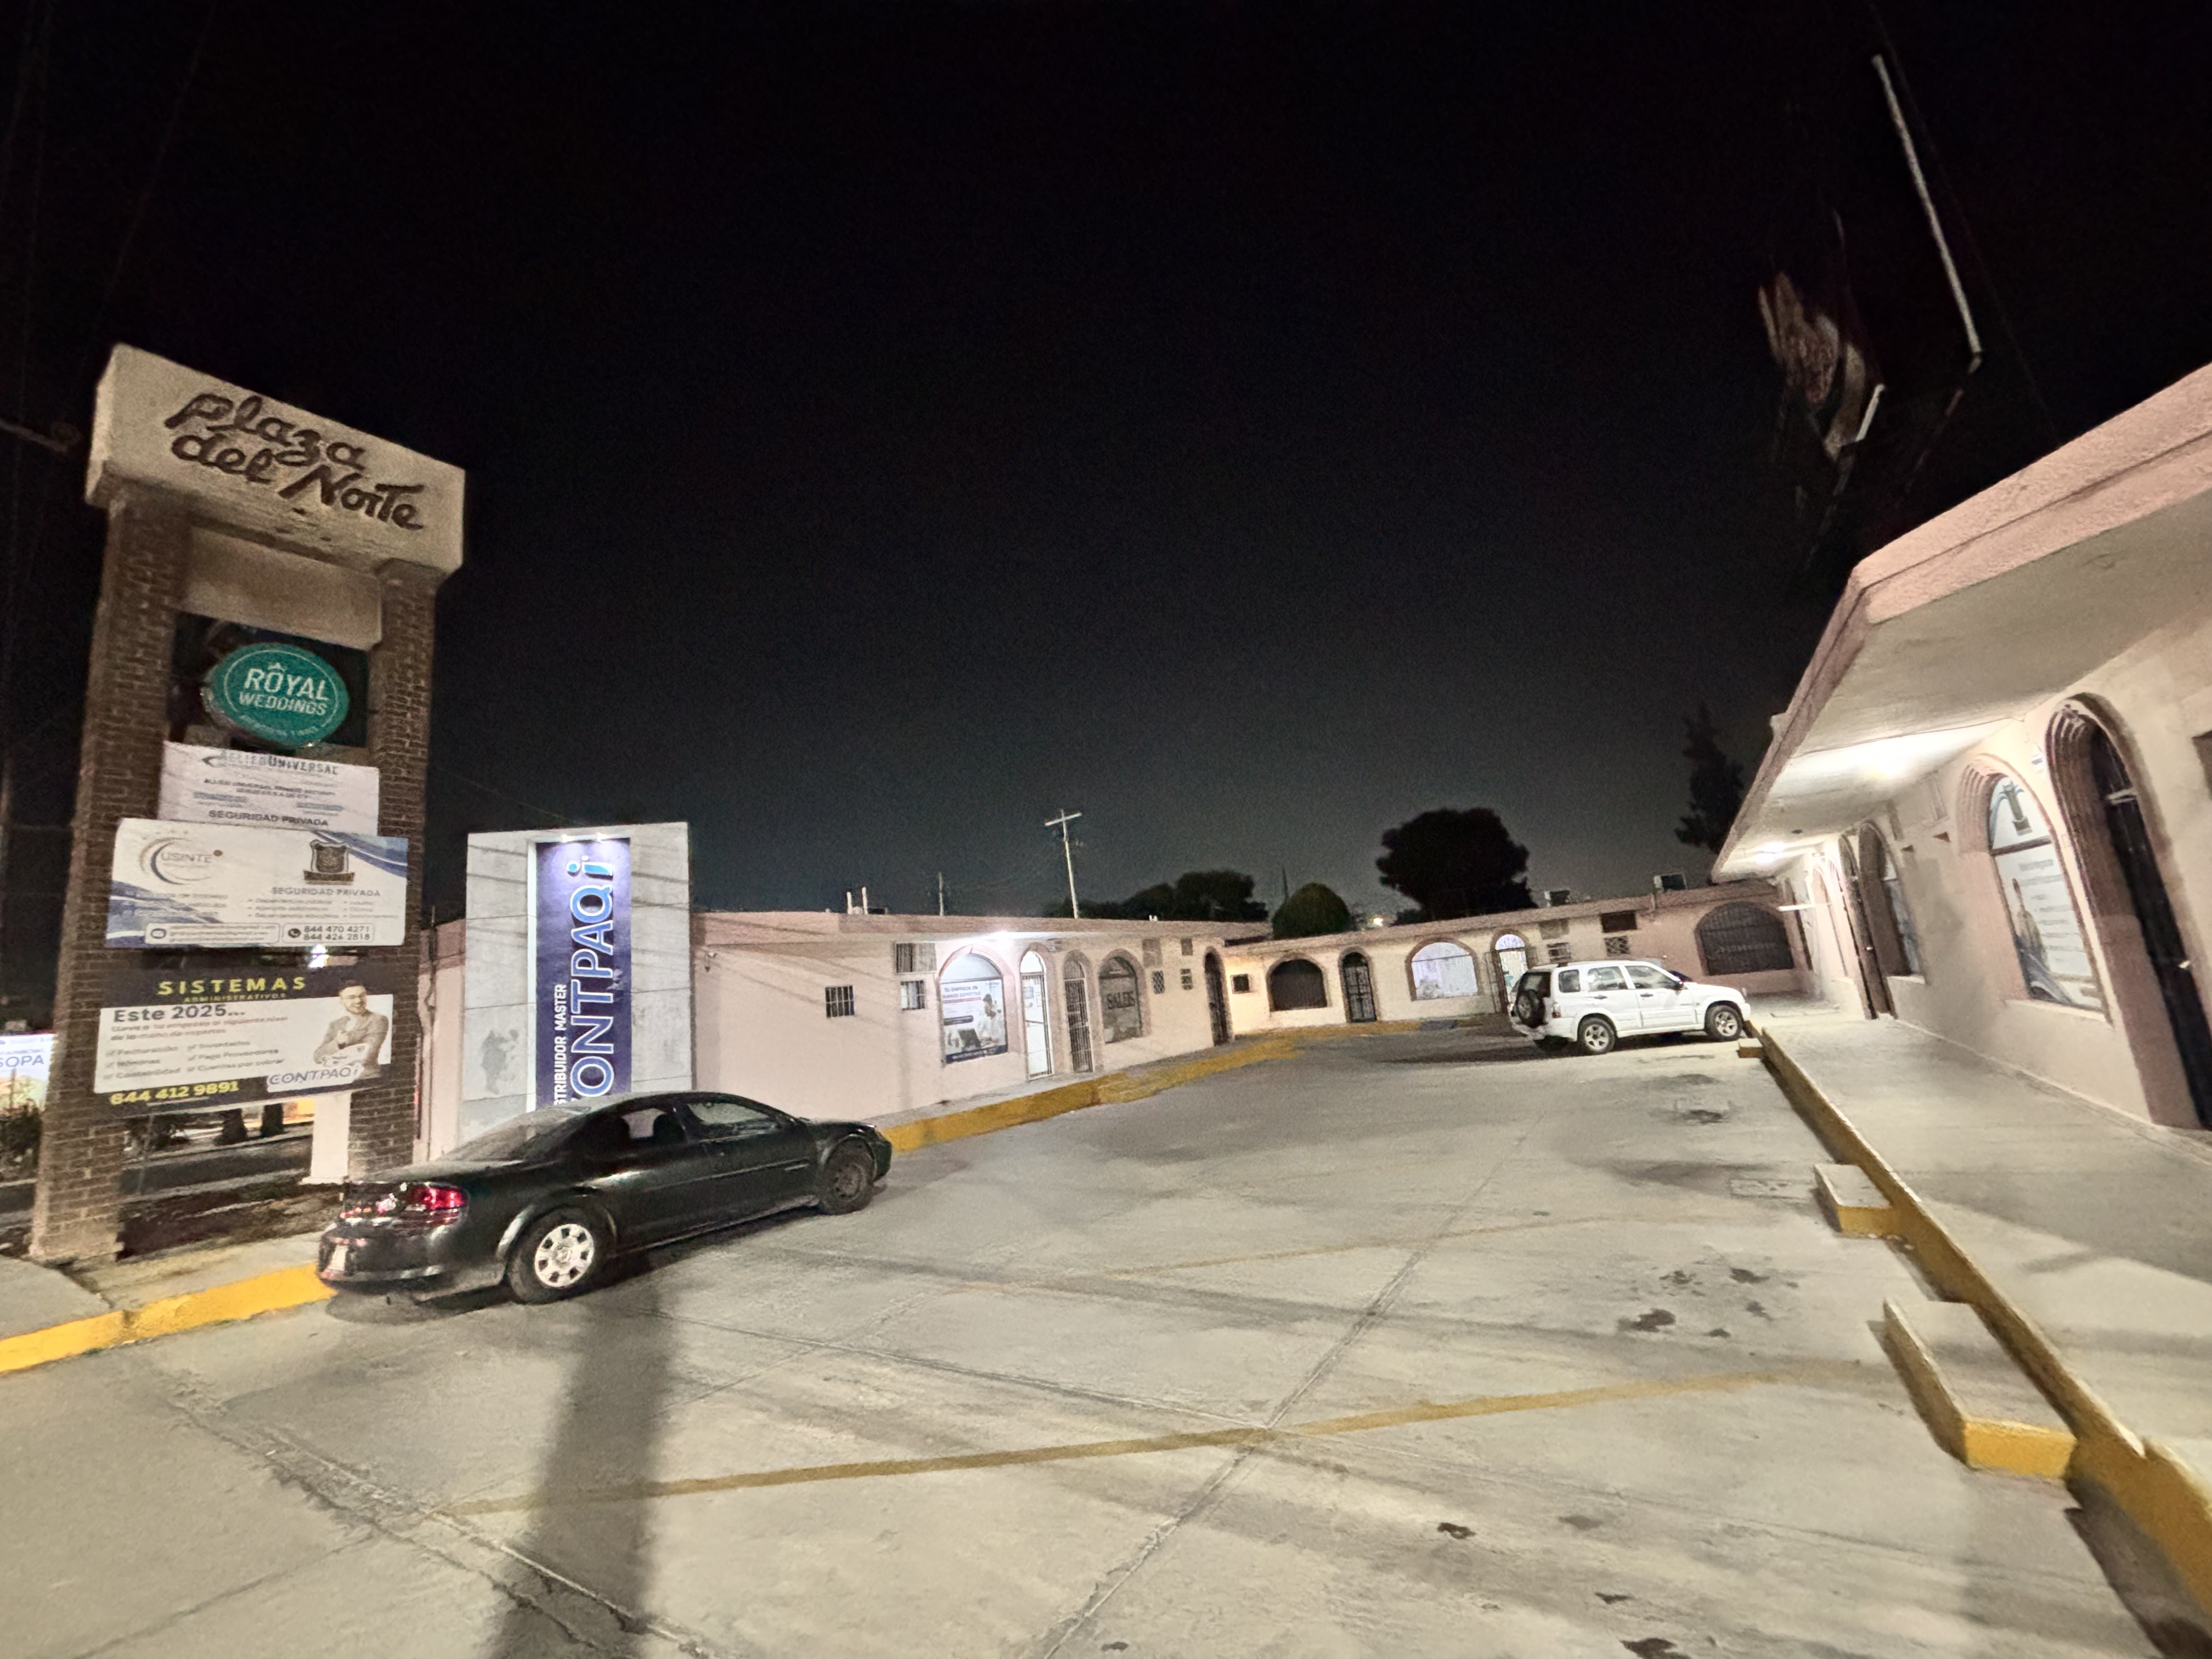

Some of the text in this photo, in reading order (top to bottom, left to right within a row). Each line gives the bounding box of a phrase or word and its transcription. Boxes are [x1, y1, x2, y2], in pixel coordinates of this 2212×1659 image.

[171, 433, 274, 484] del
[244, 668, 329, 701] ROYAL
[239, 691, 328, 715] WEDDINGS
[208, 810, 329, 826] SEGURIDAD PRIVADA
[272, 887, 380, 896] SEGURIDAD PRIVADA
[157, 977, 306, 996] SISTEMAS
[567, 861, 614, 1102] ONTPAQi
[114, 1009, 165, 1023] Este
[554, 984, 567, 1031] MASTER
[110, 1081, 239, 1105] 844 412 9891
